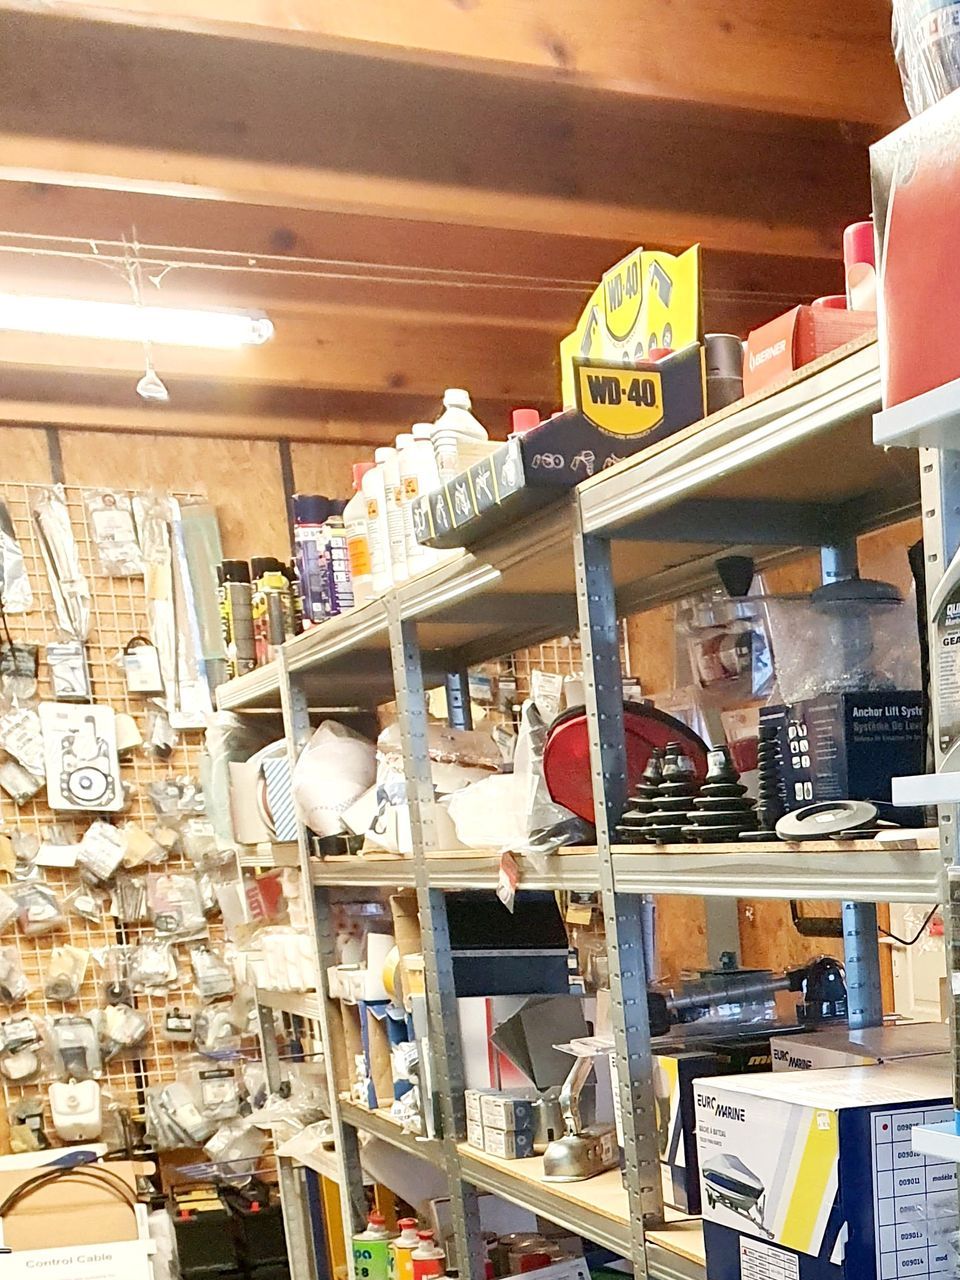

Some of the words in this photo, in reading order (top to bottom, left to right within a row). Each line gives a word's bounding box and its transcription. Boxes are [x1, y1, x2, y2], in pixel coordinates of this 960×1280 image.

[607, 261, 639, 313] WD-40
[755, 339, 787, 367] BERNER
[586, 374, 656, 408] WD-40
[852, 706, 883, 717] Anchor
[884, 706, 899, 716] Lift
[788, 1056, 813, 1069] MARINE
[714, 1103, 746, 1122] MARINE
[25, 1257, 73, 1269] Control
[76, 1253, 113, 1264] Cable
